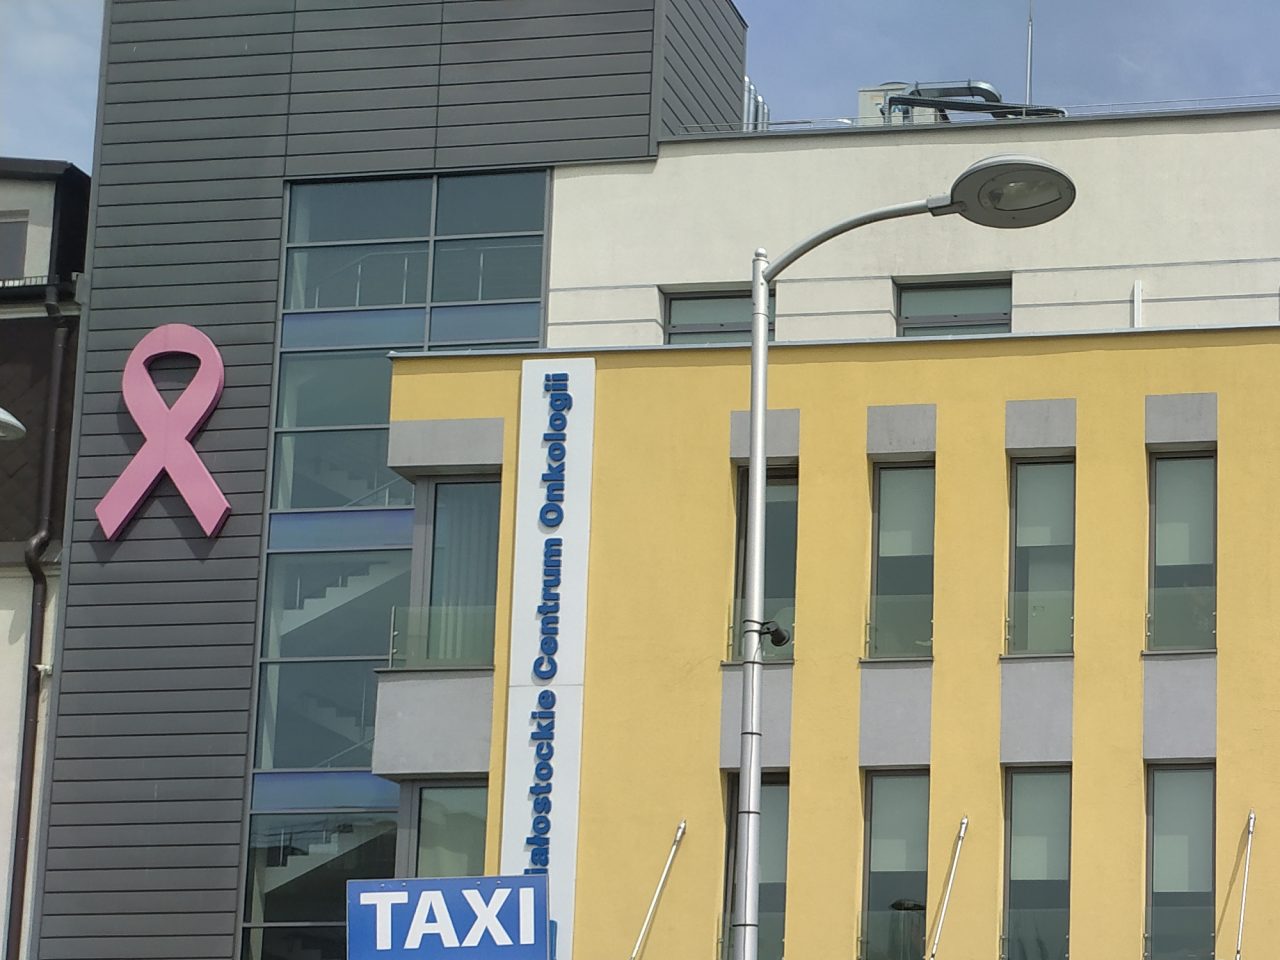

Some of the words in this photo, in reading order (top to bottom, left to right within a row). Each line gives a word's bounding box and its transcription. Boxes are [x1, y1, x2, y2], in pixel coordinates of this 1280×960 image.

[539, 372, 573, 528] Onkologii
[533, 537, 563, 680] Centrum
[525, 690, 557, 875] iałostockie
[360, 887, 535, 950] TAXI
